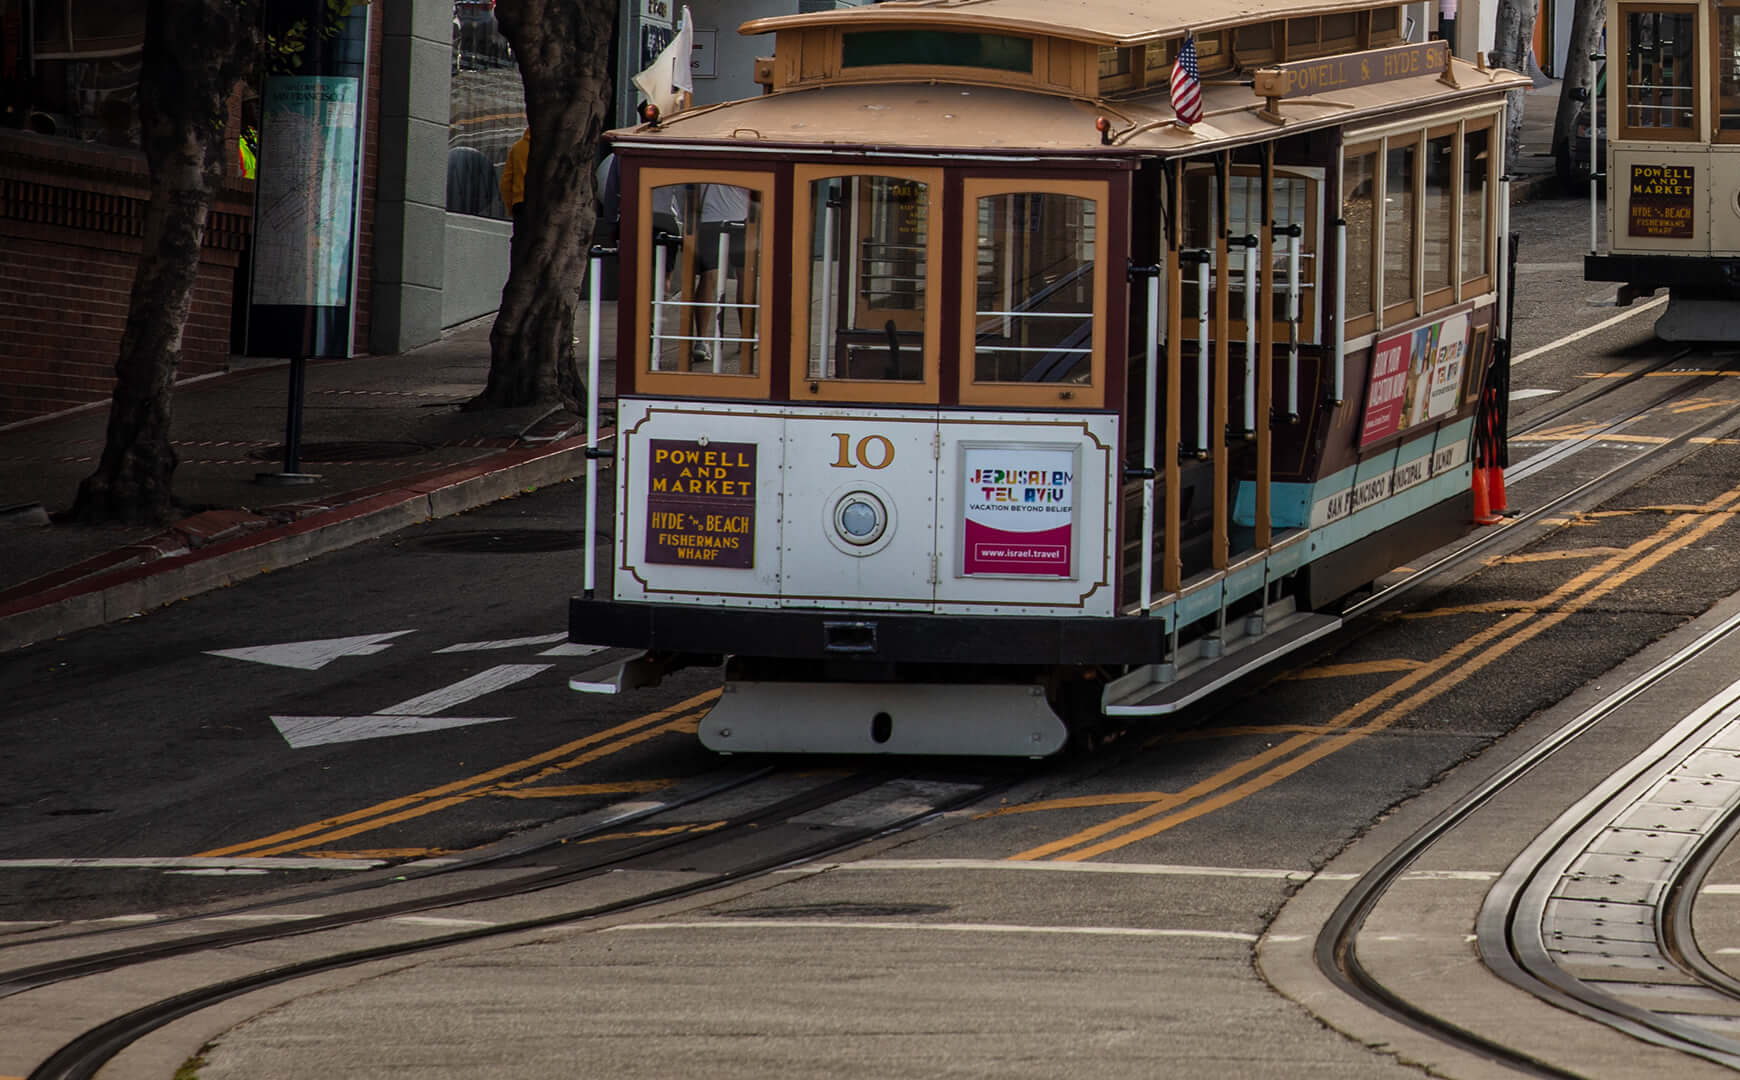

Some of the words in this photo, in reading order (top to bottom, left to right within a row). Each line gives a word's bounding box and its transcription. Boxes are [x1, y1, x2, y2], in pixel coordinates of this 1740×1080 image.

[1287, 62, 1348, 94] POWELL
[1361, 58, 1369, 81] &
[1384, 50, 1421, 77] HYDE
[1634, 168, 1692, 179] POWELL
[1650, 178, 1678, 186] AND
[1633, 185, 1693, 195] MARKET
[1632, 207, 1652, 217] HYDE
[1664, 207, 1691, 219] BEACH
[1636, 219, 1686, 228] FISHERMANS
[1647, 226, 1673, 234] WHARF
[830, 432, 896, 470] 10
[655, 449, 750, 468] POWELL
[679, 467, 728, 479] AND
[652, 478, 752, 496] MARKET
[981, 486, 1019, 502] TEL
[1327, 498, 1343, 520] SAN
[1344, 477, 1385, 512] FANCISCO
[970, 503, 1009, 512] VACATION
[1010, 505, 1044, 513] BEYOND
[652, 512, 686, 531] HYDE
[706, 515, 750, 534] BEACH
[658, 533, 740, 549] FISHERMANS
[677, 548, 721, 561] WHARF
[980, 548, 1061, 559] www.israel.travel
